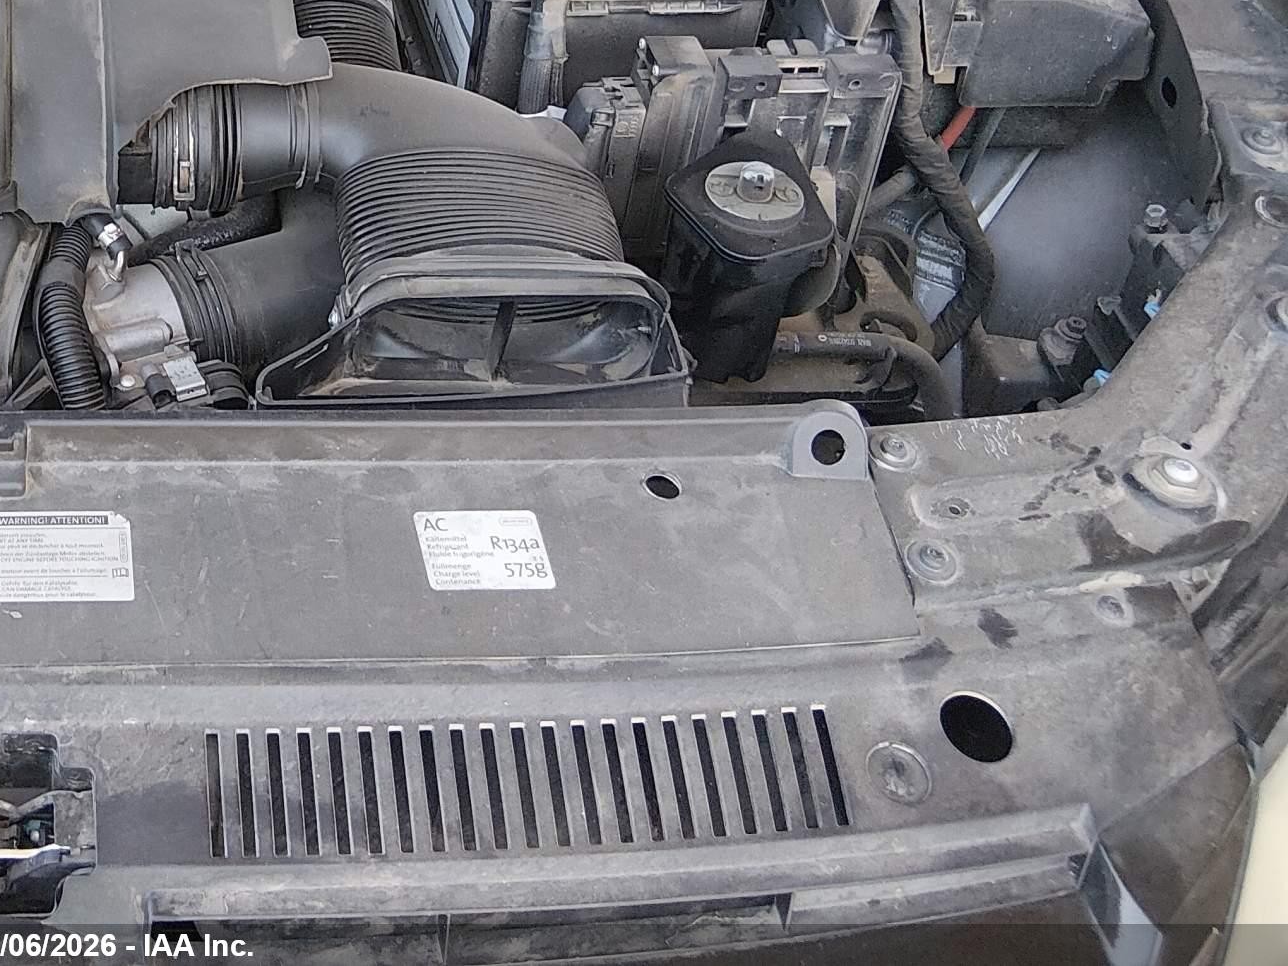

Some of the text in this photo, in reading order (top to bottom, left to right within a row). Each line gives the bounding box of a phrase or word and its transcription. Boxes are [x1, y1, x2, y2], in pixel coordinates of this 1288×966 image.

[50, 516, 105, 525] ATTENTION!
[423, 517, 449, 532] AC
[489, 535, 541, 554] R134a
[503, 562, 549, 579] 575g
